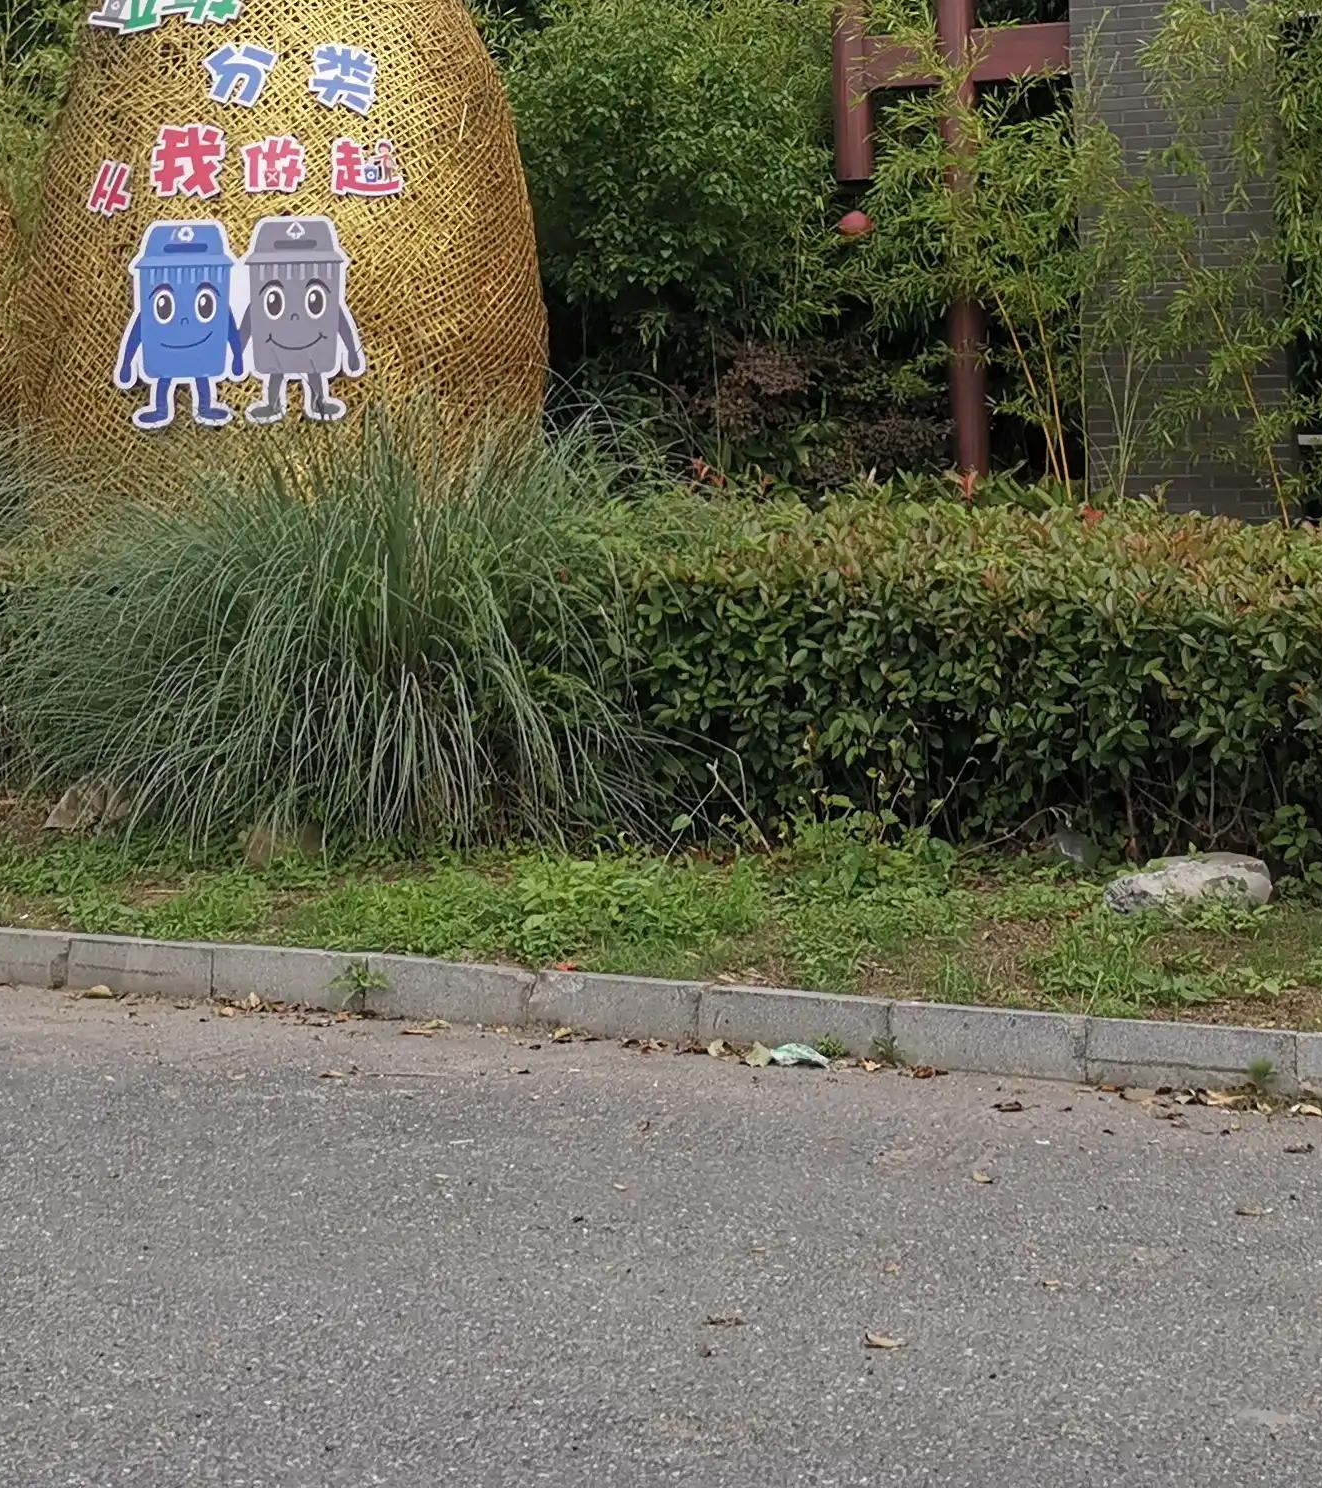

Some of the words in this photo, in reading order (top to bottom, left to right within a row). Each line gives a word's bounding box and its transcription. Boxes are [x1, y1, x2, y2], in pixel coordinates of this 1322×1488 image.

[204, 44, 377, 112] 分类
[89, 125, 403, 213] 从我做起
